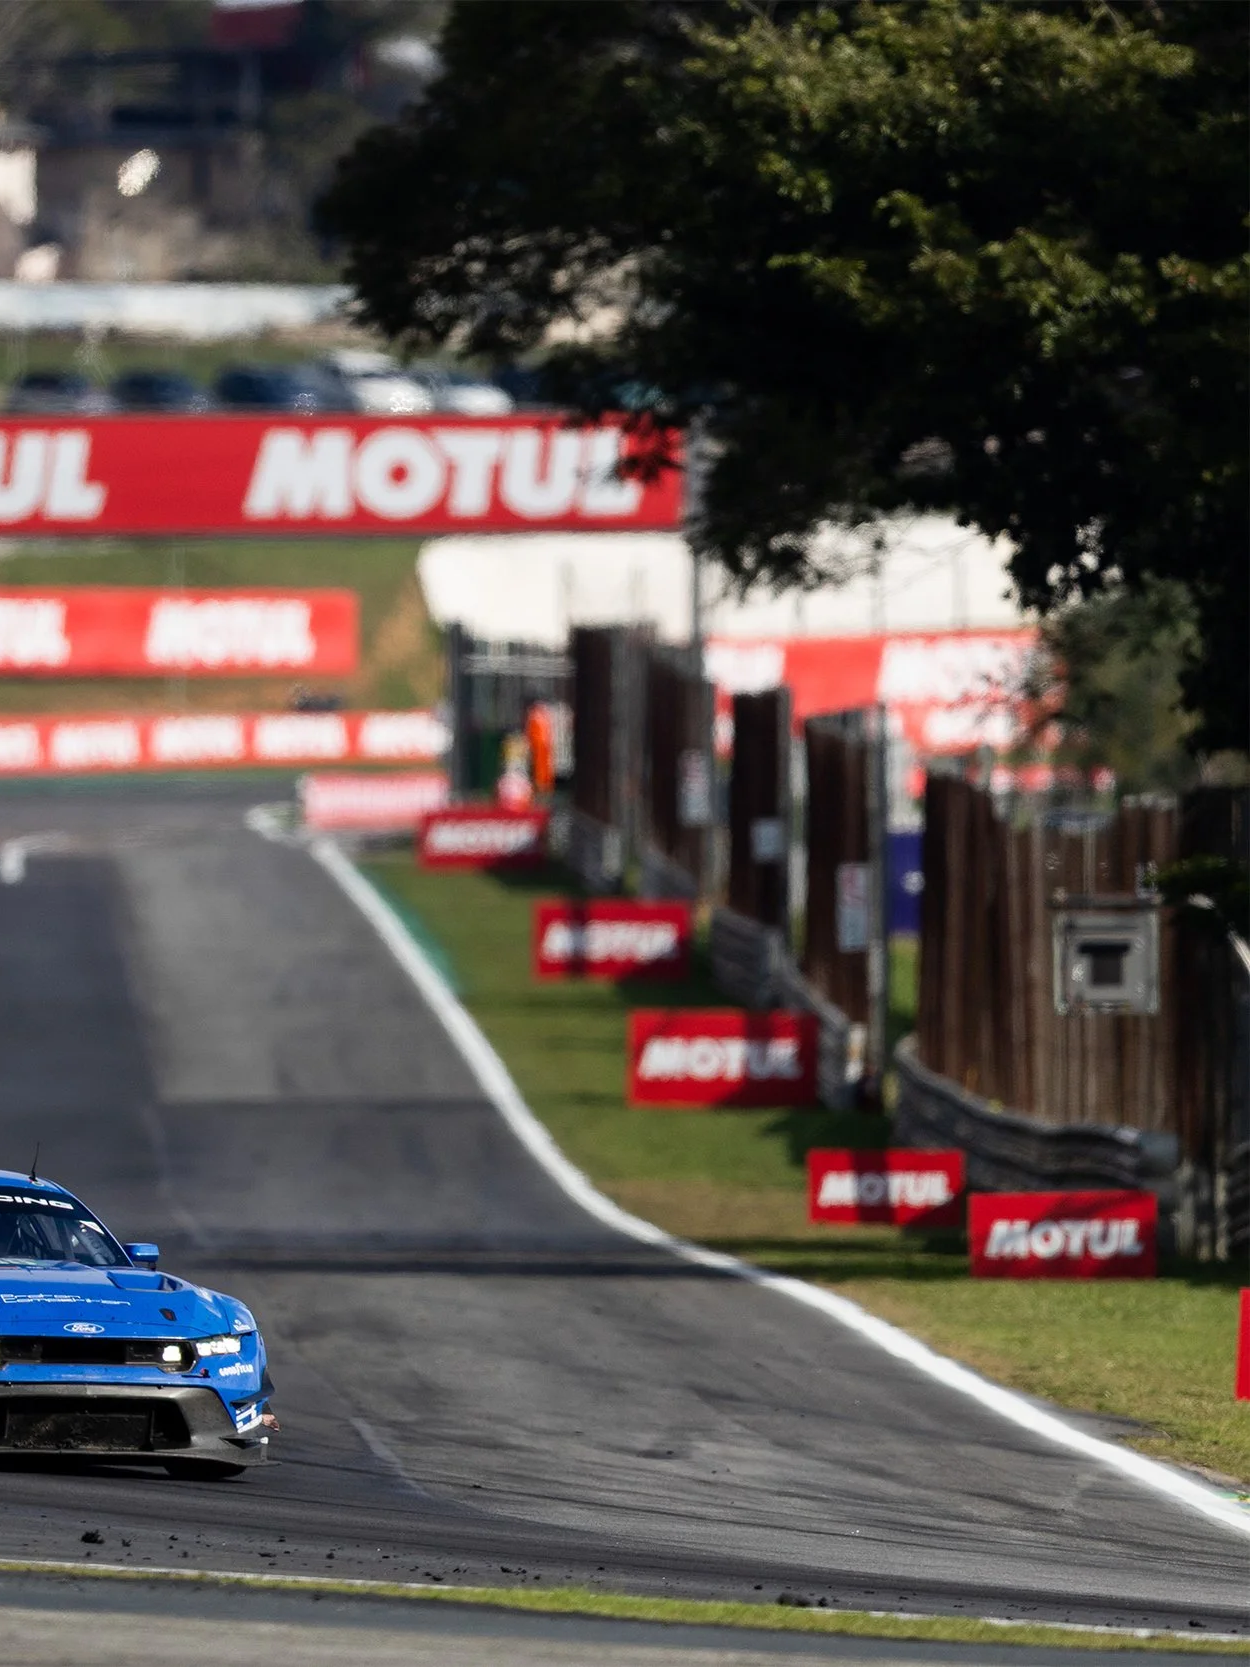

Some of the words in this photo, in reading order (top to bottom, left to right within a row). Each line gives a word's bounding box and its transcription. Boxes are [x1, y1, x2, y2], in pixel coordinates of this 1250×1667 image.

[244, 428, 644, 520] MOTUL
[639, 1036, 801, 1080] MOTUL
[817, 1171, 953, 1207] MOTUL
[986, 1219, 1144, 1259] MOTUL
[219, 1362, 254, 1377] GOODYEAR
